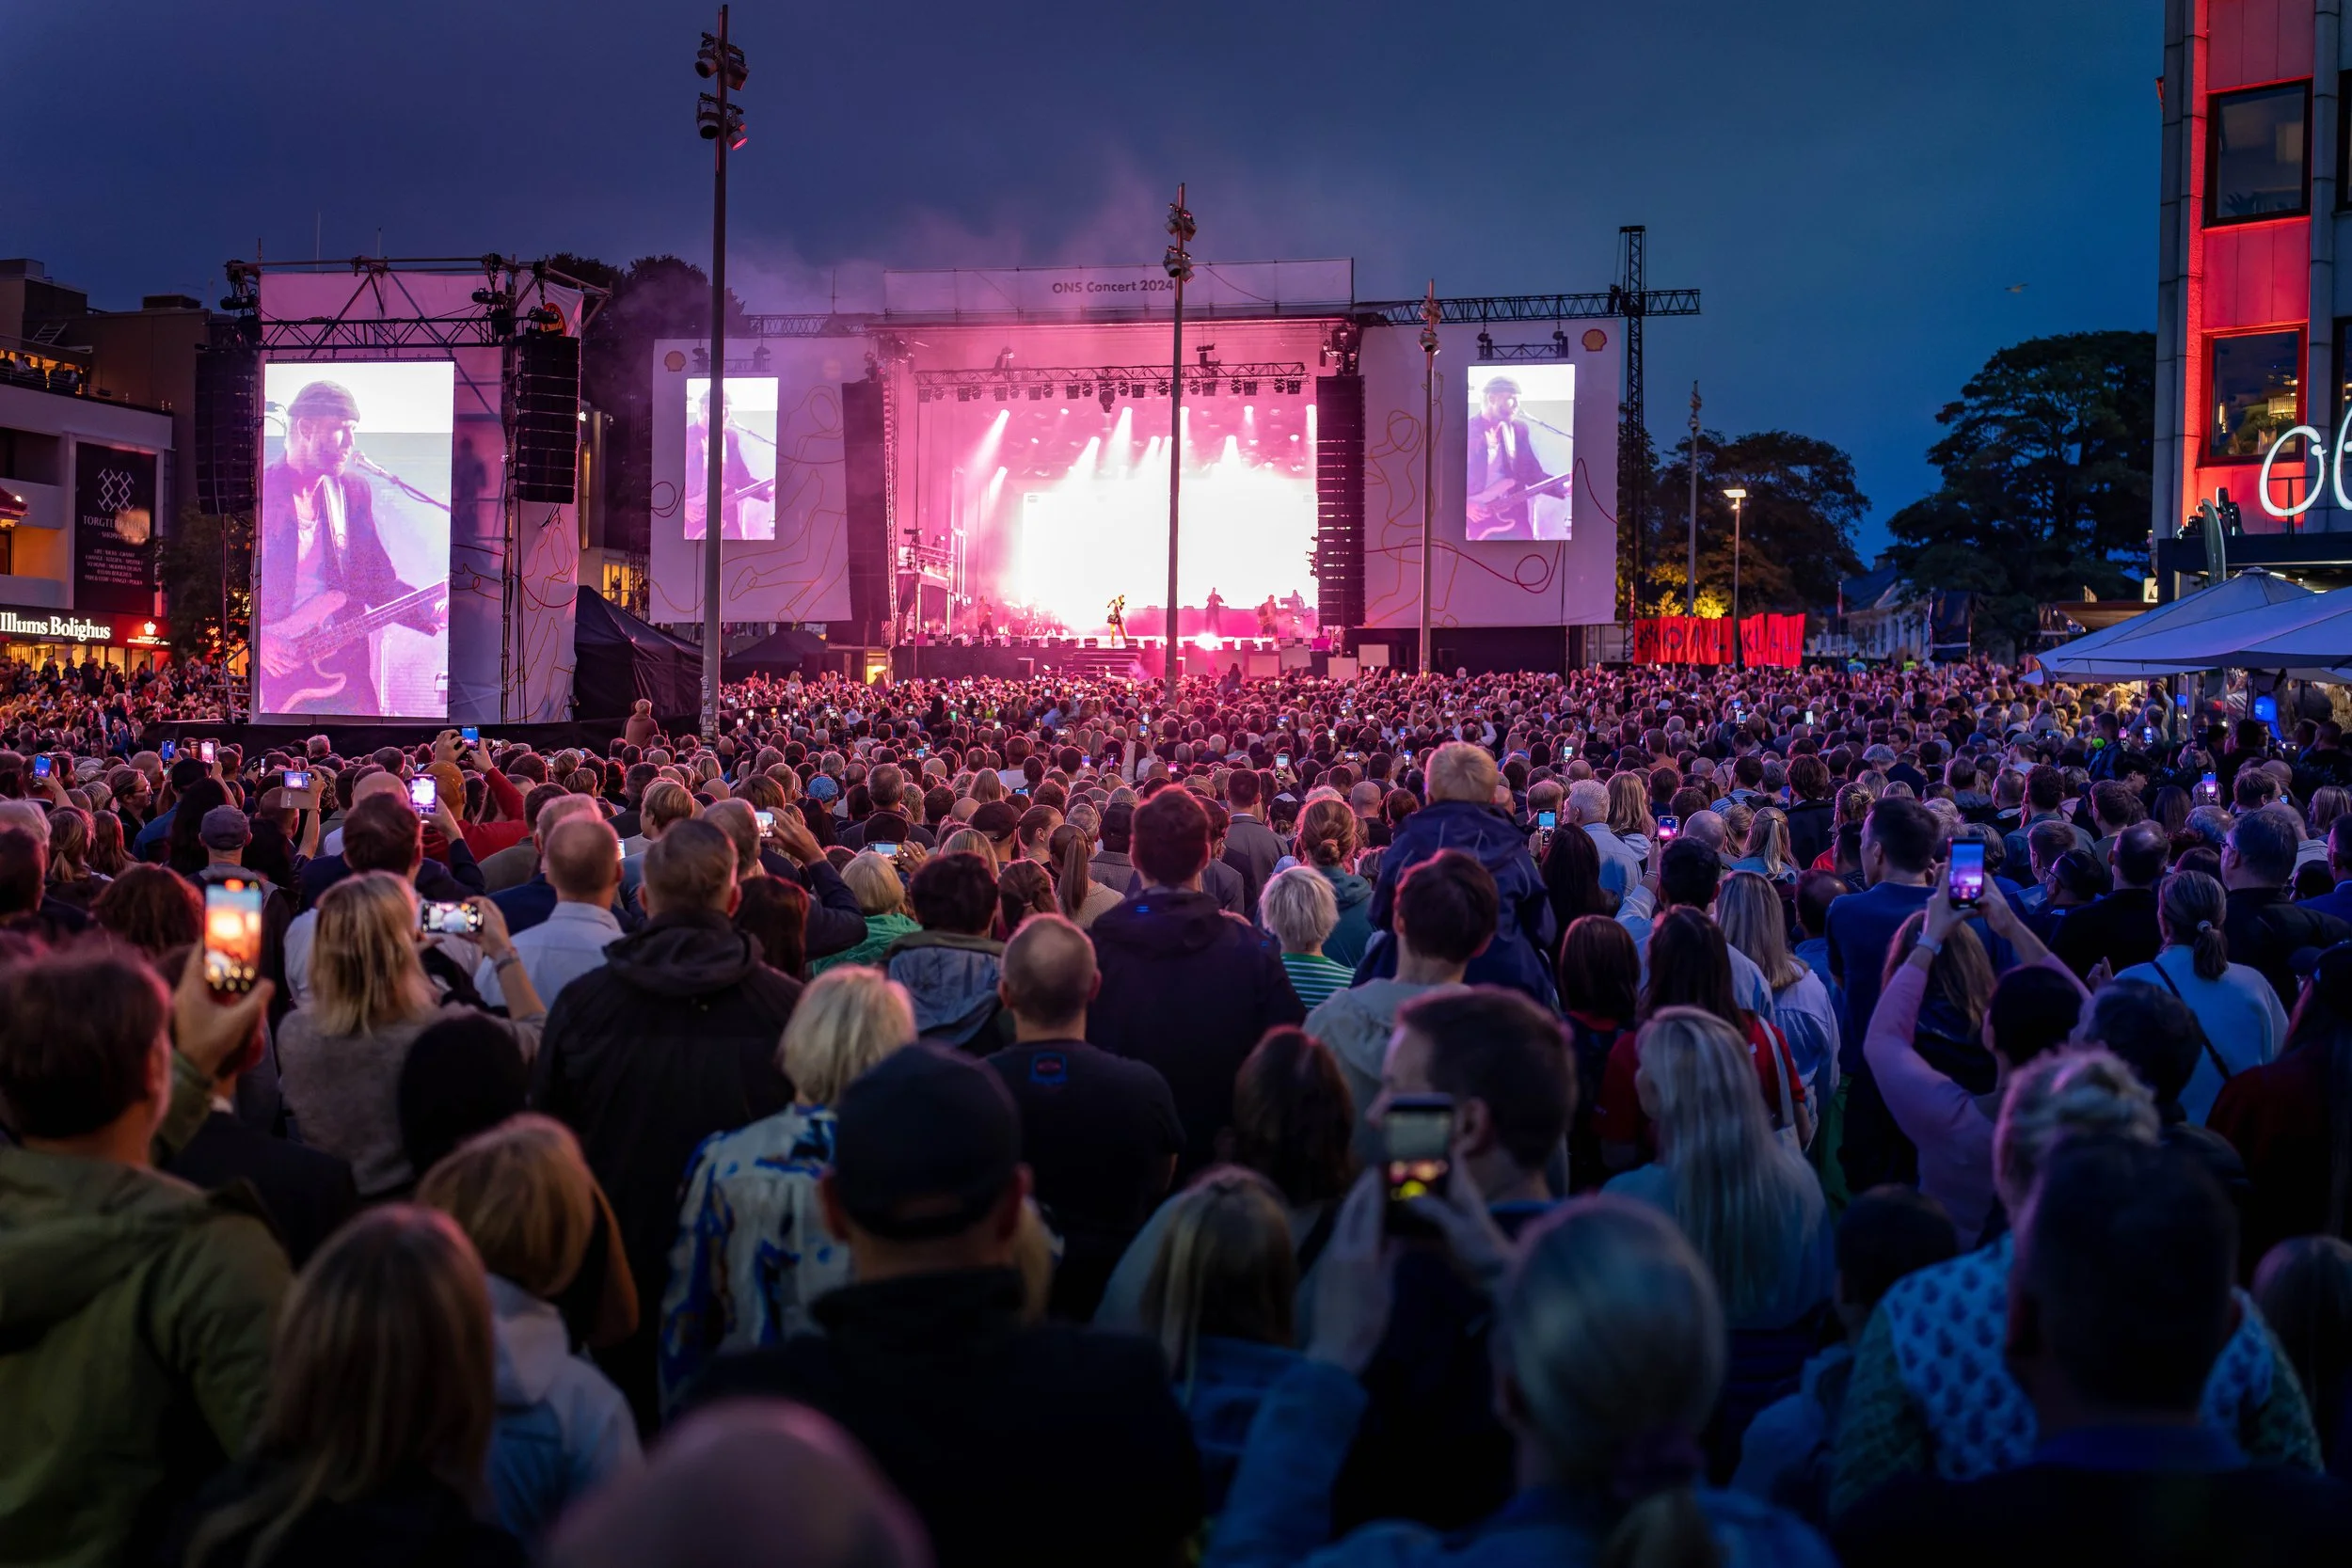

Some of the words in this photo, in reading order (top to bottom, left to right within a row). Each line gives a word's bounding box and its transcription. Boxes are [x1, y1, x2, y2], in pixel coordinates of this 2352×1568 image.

[1052, 282, 1082, 293] ONS
[1087, 281, 1136, 293] Concert
[1140, 279, 1174, 292] 2024
[0, 611, 48, 635] Illums
[50, 616, 110, 641] Bolighus
[1665, 626, 1726, 651] OIL
